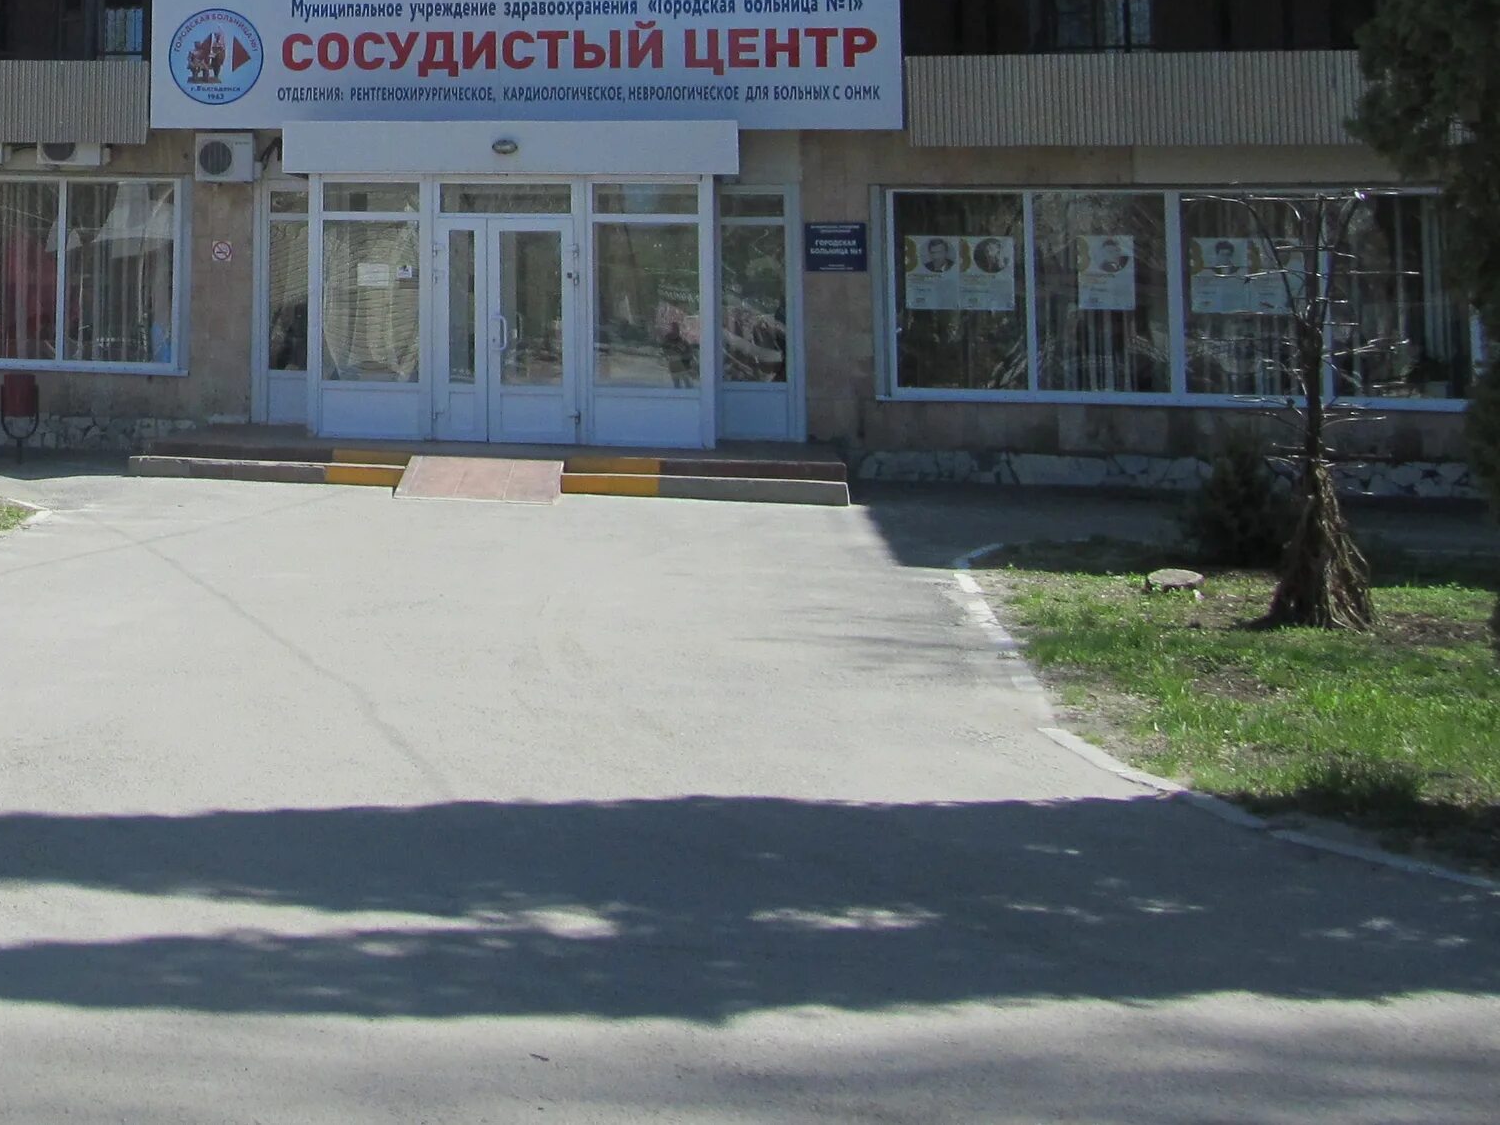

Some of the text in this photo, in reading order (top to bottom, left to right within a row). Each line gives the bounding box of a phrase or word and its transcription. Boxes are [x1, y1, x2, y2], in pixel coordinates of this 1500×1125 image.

[409, 0, 497, 22] учреждение
[281, 20, 878, 78] СОСУДИСТЫЙ ЦЕНТР
[276, 84, 881, 103] ОТДЕЛЕНИЯ: РЕНТГЕНОХИРУРГИЧЕСКОЕ, КАРДИОЛОГИЧЕСКОЕ, НЕВРОЛОГИЧЕСКОЕ ДЛЯ БОЛЬНЫХ С ОНМК
